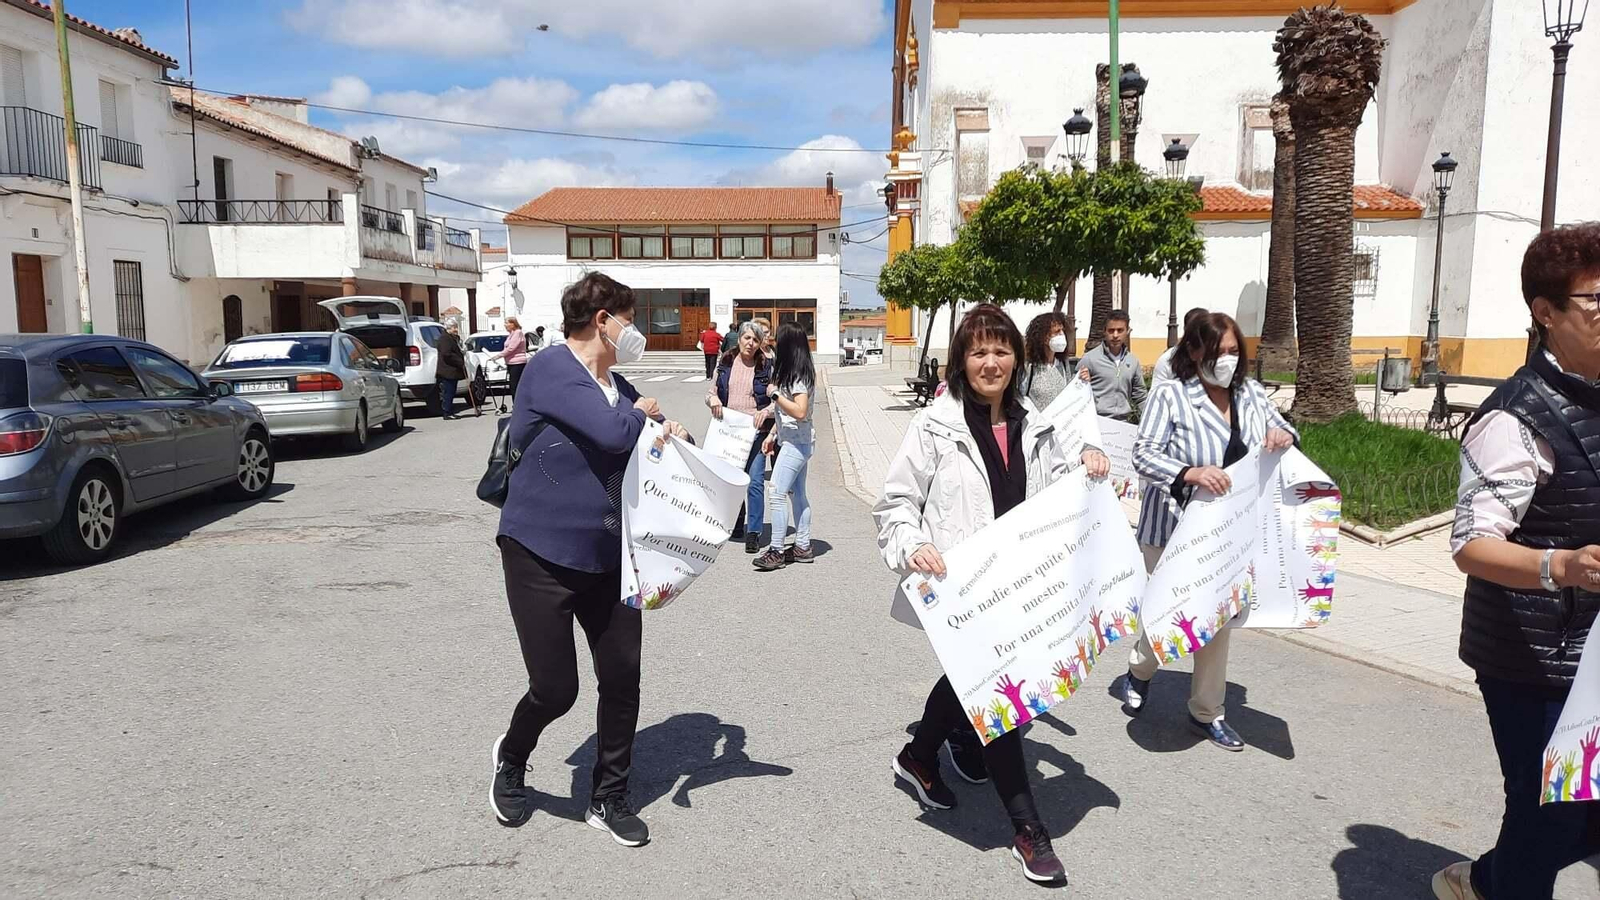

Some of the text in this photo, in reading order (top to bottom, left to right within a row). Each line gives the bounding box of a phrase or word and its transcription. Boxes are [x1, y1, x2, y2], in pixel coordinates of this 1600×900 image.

[242, 382, 261, 391] 1137
[643, 479, 725, 530] Que nadie nos
[642, 531, 664, 546] Por
[665, 541, 688, 556] una
[1165, 509, 1244, 562] nadie nos quite lo
[1274, 507, 1283, 544] ermita
[947, 520, 1102, 630] Que nadie nos quite lo que es
[1171, 582, 1191, 598] Por
[1193, 575, 1214, 588] una
[1215, 553, 1240, 577] ermita
[1278, 547, 1286, 567] una
[1022, 580, 1068, 613] nuestro.
[1278, 570, 1287, 589] Por
[993, 639, 1016, 657] Por
[1020, 624, 1043, 643] una
[1045, 598, 1079, 627] ermita
